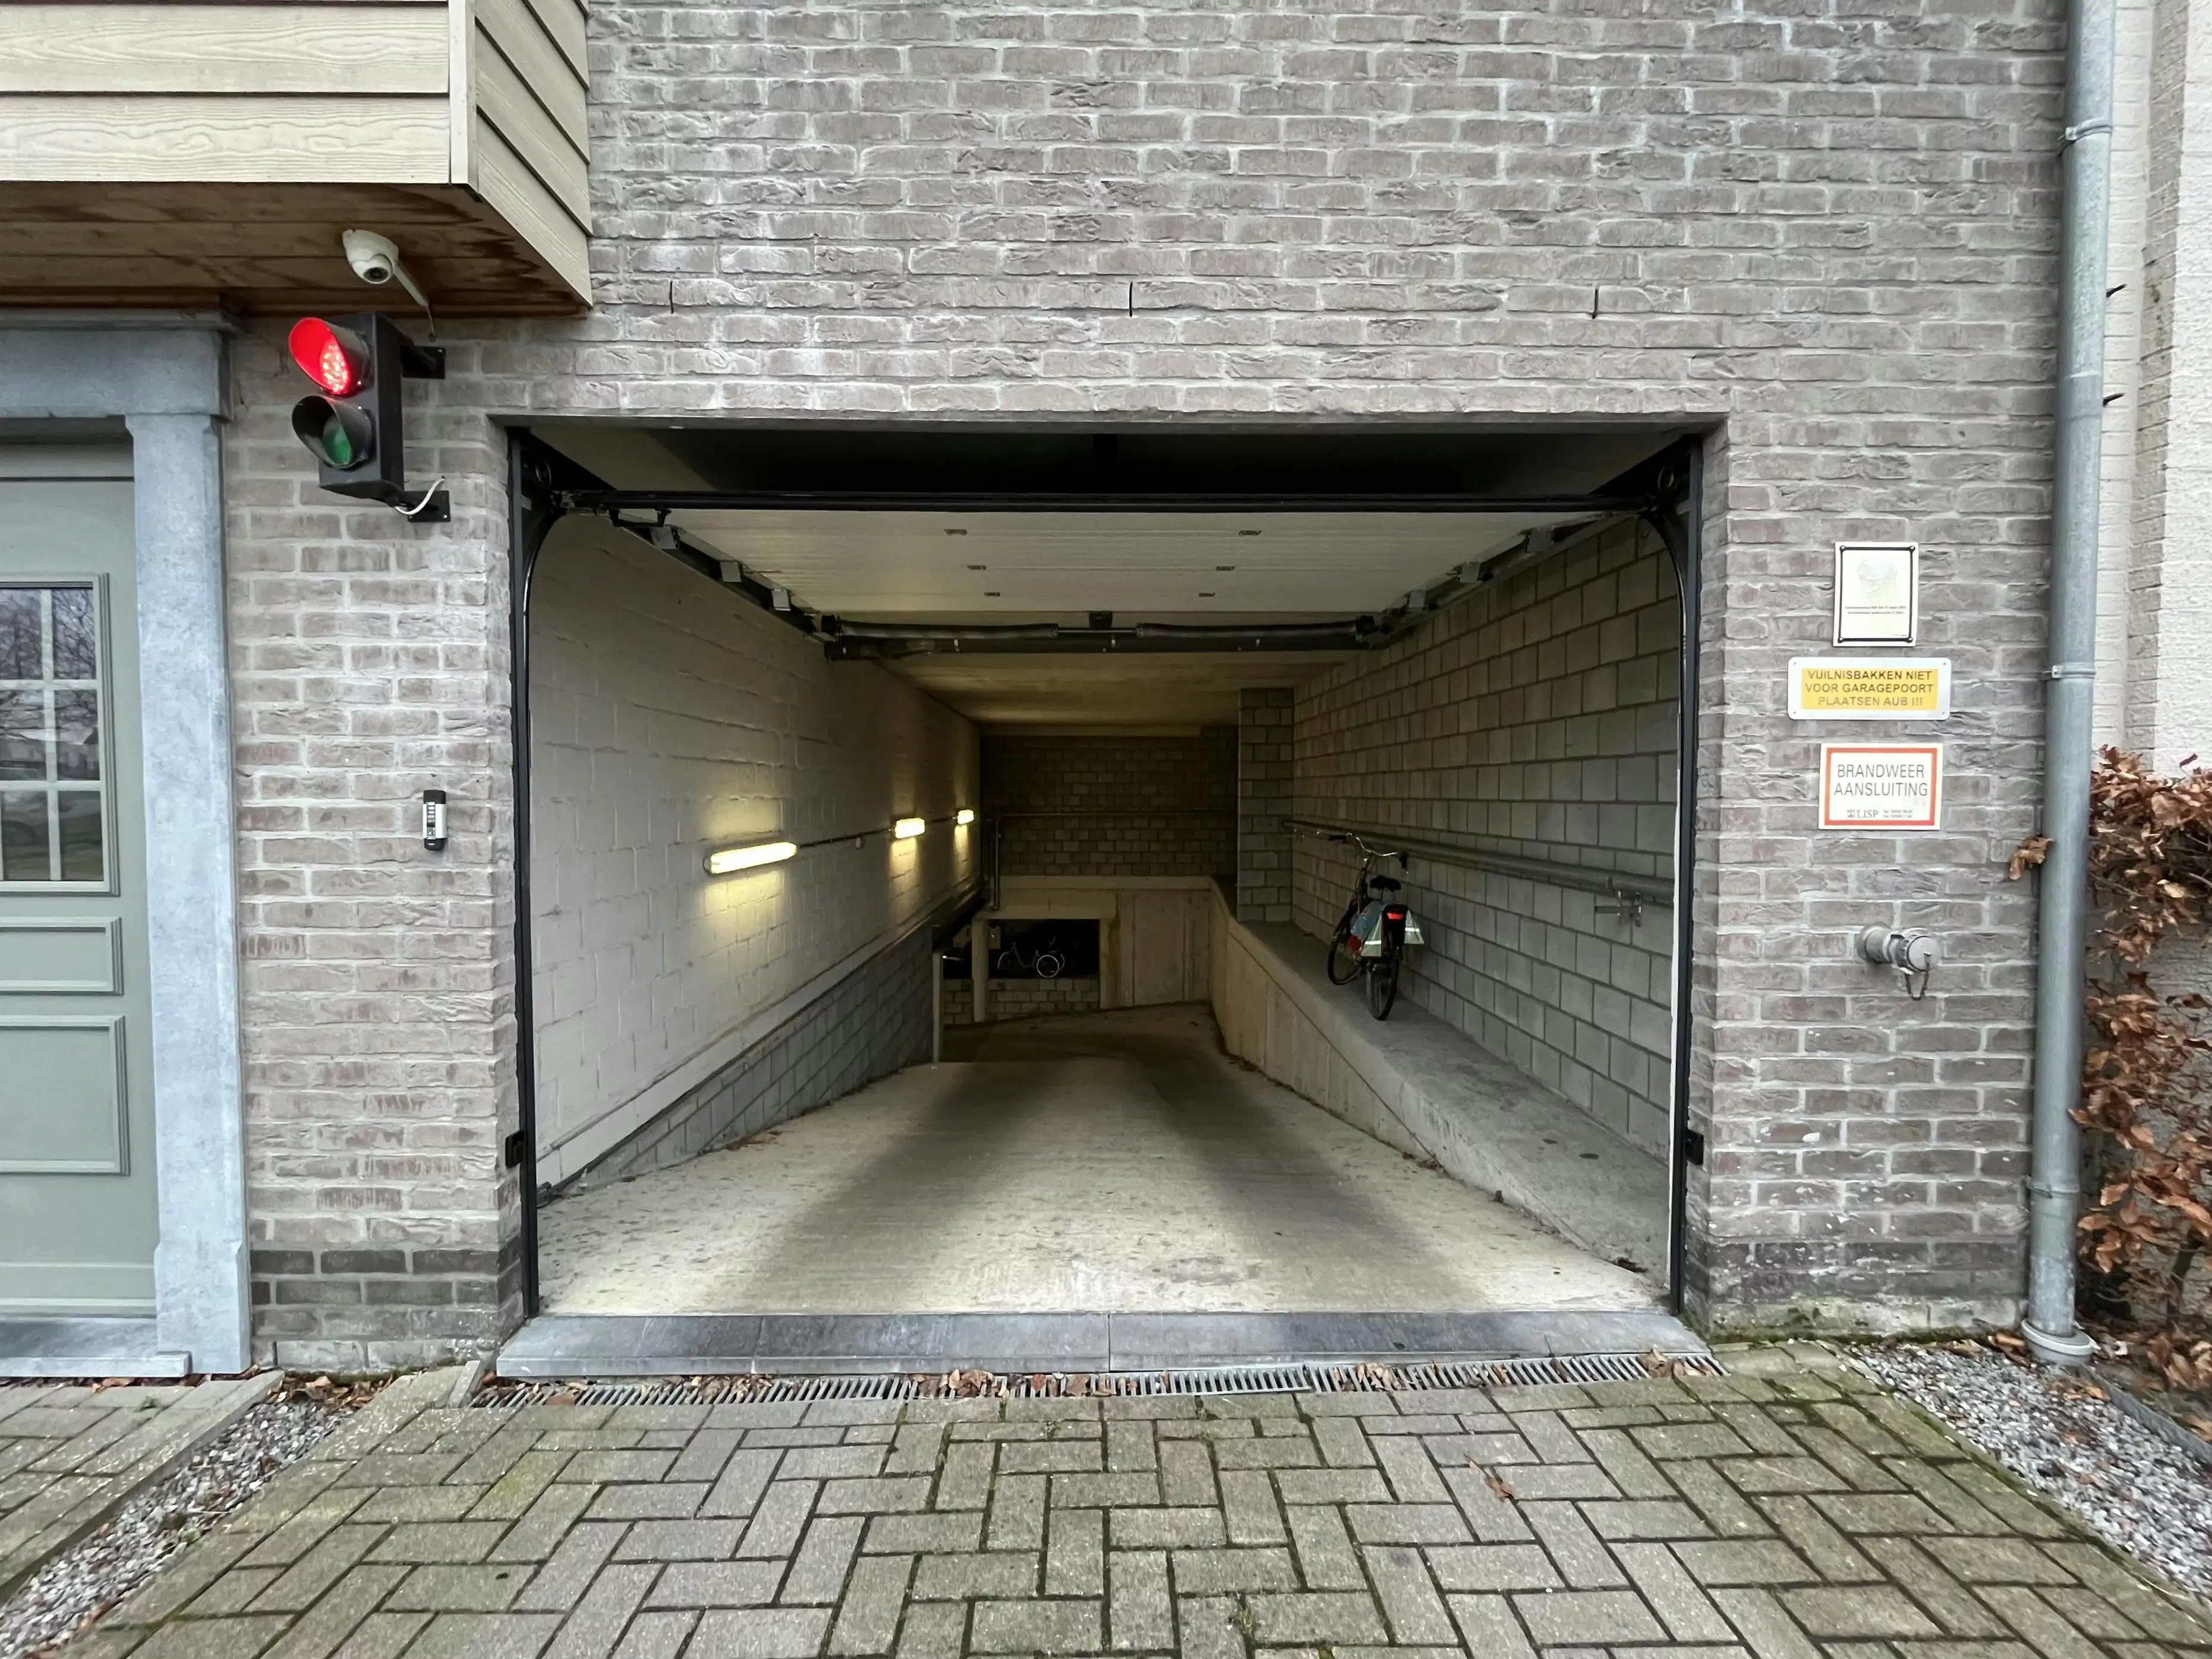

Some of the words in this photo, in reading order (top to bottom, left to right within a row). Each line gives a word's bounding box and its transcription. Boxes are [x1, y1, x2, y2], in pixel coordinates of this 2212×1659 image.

[1807, 670, 1902, 680] VUILNISBAKKEN
[1906, 670, 1932, 680] NIET
[1805, 683, 1838, 693] VOOR
[1842, 683, 1934, 693] GARAGEPOORT
[1818, 696, 1880, 706] PLAATSEN
[1883, 696, 1908, 706] AUB
[1837, 764, 1925, 778] BRANDWEER
[1833, 783, 1928, 796] AANSLUITING
